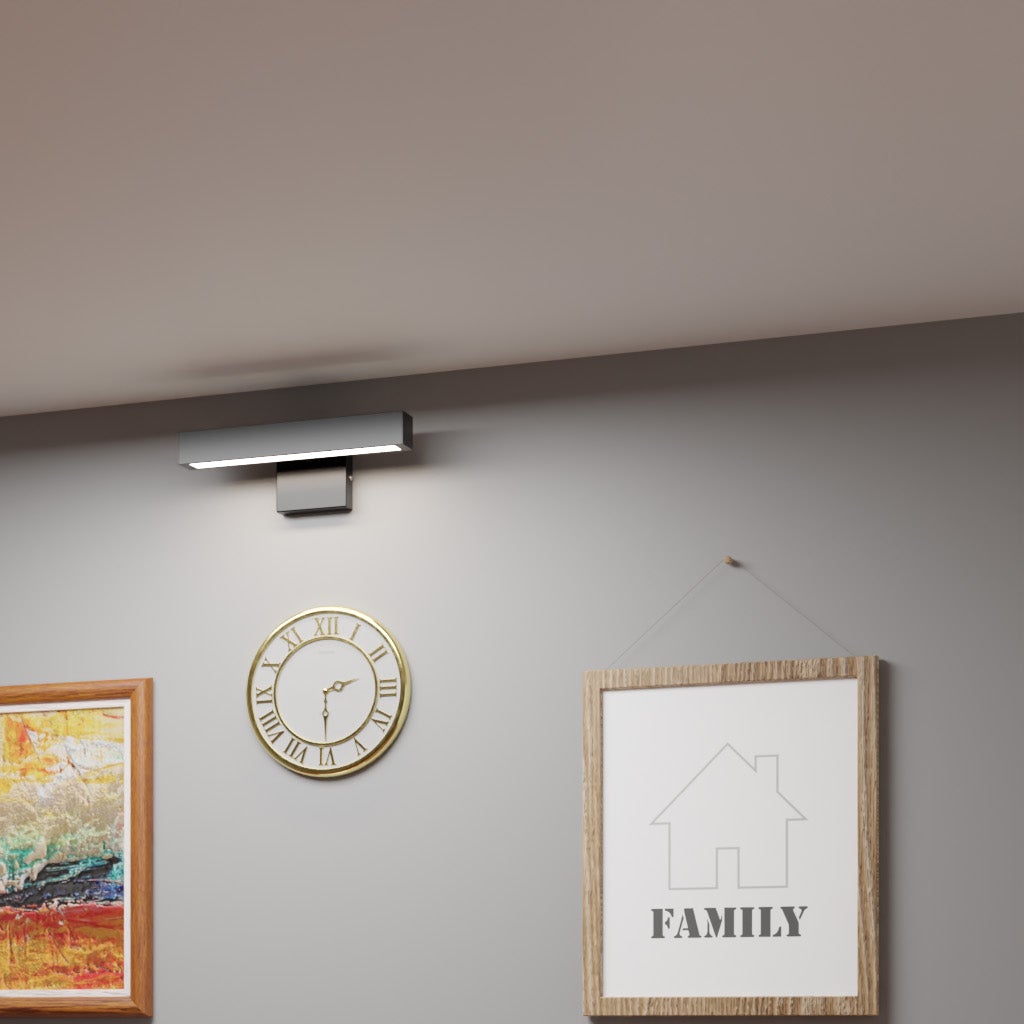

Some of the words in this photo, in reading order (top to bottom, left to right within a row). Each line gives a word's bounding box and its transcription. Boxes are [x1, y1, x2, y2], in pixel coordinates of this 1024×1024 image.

[314, 617, 339, 636] XII
[350, 623, 361, 641] I
[280, 627, 303, 651] XI
[369, 644, 388, 662] II
[261, 657, 281, 673] X
[256, 686, 273, 704] IX
[379, 678, 397, 698] III
[259, 710, 285, 744] VIII
[372, 709, 392, 732] IV
[284, 738, 308, 764] VII
[318, 747, 336, 766] VI
[354, 738, 368, 756] V
[651, 906, 808, 939] FAMILY
